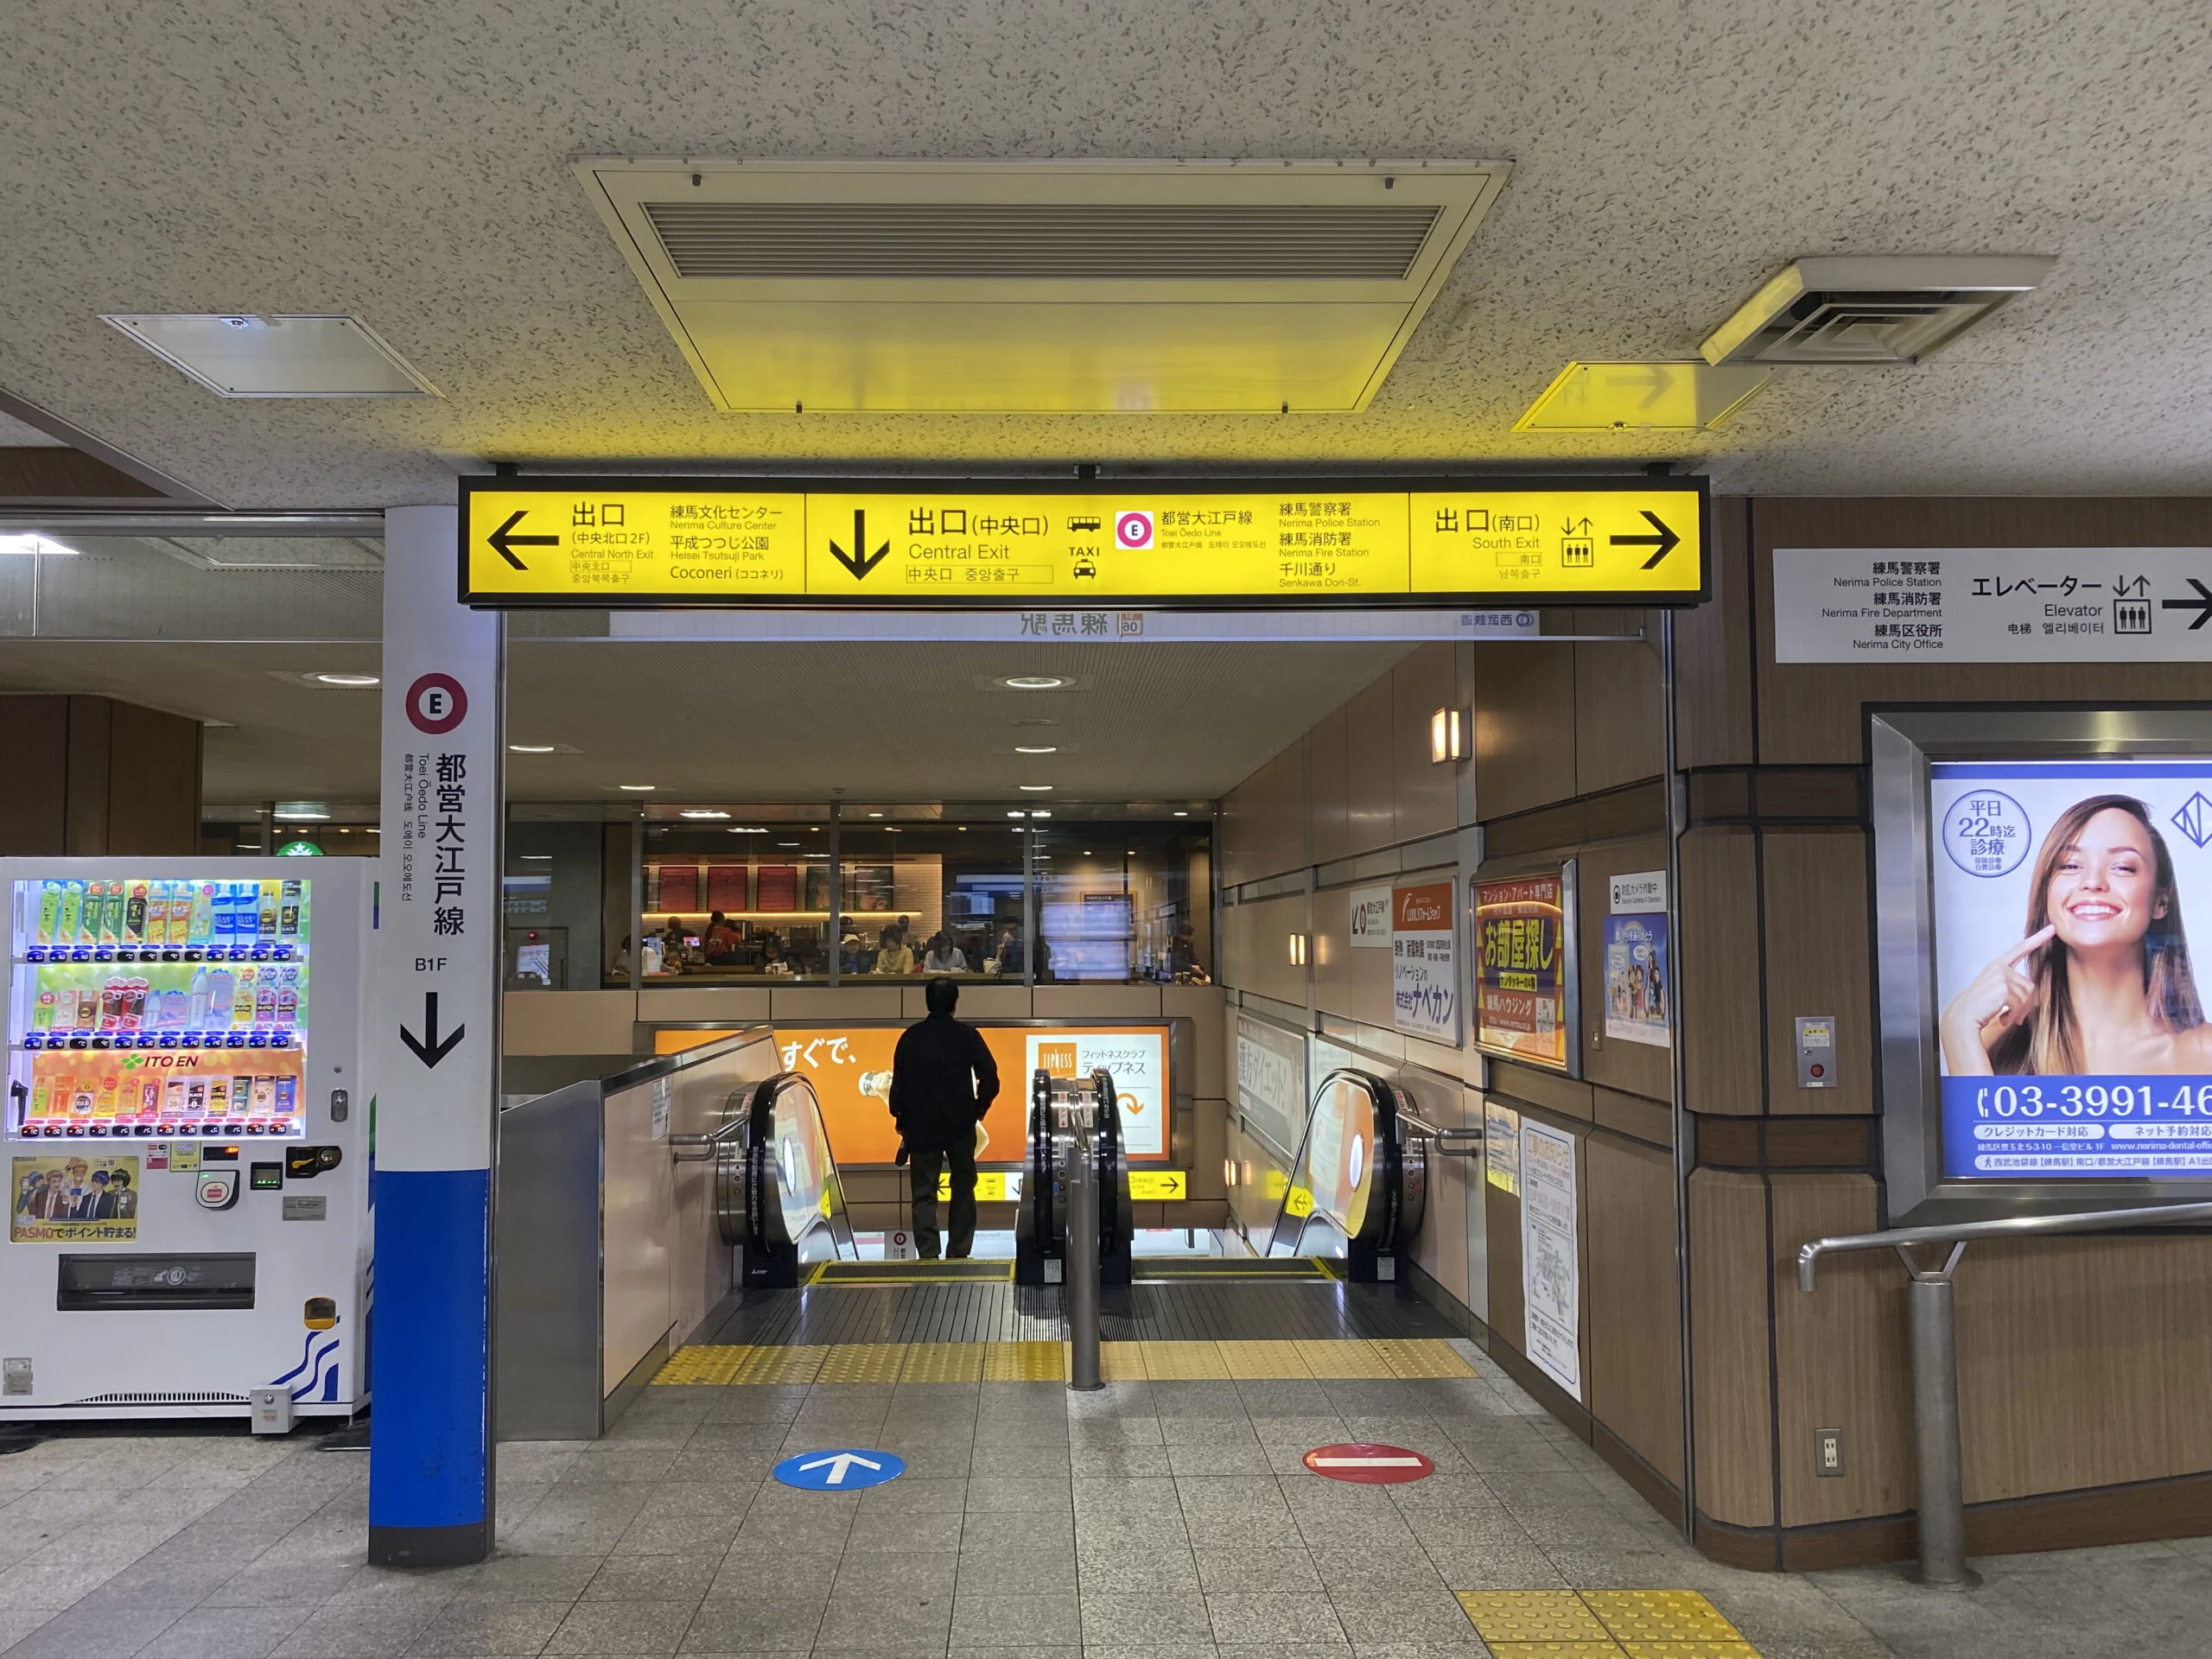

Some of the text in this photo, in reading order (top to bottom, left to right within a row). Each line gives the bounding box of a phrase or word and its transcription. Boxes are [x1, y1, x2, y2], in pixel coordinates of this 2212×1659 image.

[572, 501, 625, 527] 出口
[670, 505, 783, 519] 練馬文化センター
[1279, 502, 1352, 517] 練馬警察署
[1160, 510, 1253, 525] 都営大江戸線
[1279, 517, 1380, 527] Nerima Police Station
[671, 520, 777, 530] Nerima Culture Center
[1131, 524, 1138, 536] E
[1160, 528, 1178, 537] Toei
[1205, 528, 1222, 537] Line
[1279, 531, 1352, 547] 練馬消防署
[670, 536, 769, 550] 平成つつじ公園
[1472, 537, 1541, 550] South Exit
[571, 549, 654, 559] Central North Exit
[671, 550, 765, 562] Heisei Tsutsuji Park
[908, 543, 1010, 560] Central Exit
[1068, 546, 1100, 556] TAXI
[1279, 547, 1370, 557] Nerima Fire Station
[571, 562, 610, 571] 中央北口
[1520, 554, 1541, 566] 南口
[670, 565, 784, 581] Coconeri (ココネリ)
[908, 567, 1020, 582] 中央口 중앙출구
[1279, 562, 1336, 577] 千川通り
[1499, 569, 1541, 580] 남쪽출구
[1872, 561, 1941, 575] 練馬警察署
[571, 573, 630, 584] 중앙북쪽출구
[1279, 577, 1362, 588] Senkawa Dori-St.
[1834, 576, 1942, 588] Nerima Police Station
[1972, 575, 2102, 598] エレベーター
[1873, 592, 1942, 607] 練馬消防署
[1821, 607, 1942, 620] Nerima Fire Department
[2044, 603, 2103, 618] Elevator
[1874, 624, 1942, 638] 練馬区役所
[2007, 621, 2105, 636] 电梯 엘리베이터
[1853, 639, 1943, 652] Nerima City Office
[429, 692, 442, 715] E
[417, 753, 431, 838] Toei Ōedo Line
[1969, 800, 2002, 817] 平日
[1958, 817, 2016, 838] 22時迄
[403, 821, 413, 849] 도에이
[434, 753, 467, 936] 都営大江戸線
[1970, 838, 2005, 856] 診療
[402, 854, 413, 901] 오오에도선
[1485, 918, 1554, 970] お部屋探し
[415, 957, 448, 971] B1F
[1486, 993, 1533, 1017] 練馬ハウジング
[781, 1036, 856, 1072] すぐで、
[1043, 1051, 1072, 1069] TIPNESS
[1082, 1050, 1147, 1059] フィットネスクラブ
[144, 1056, 199, 1068] ITO EN
[1984, 1126, 2088, 1138] クレジットカード対応
[2134, 1126, 2212, 1137] ネット予約対応
[2095, 1142, 2106, 1151] 1F
[14, 1226, 137, 1239] PASMOでポイント貯まる!
